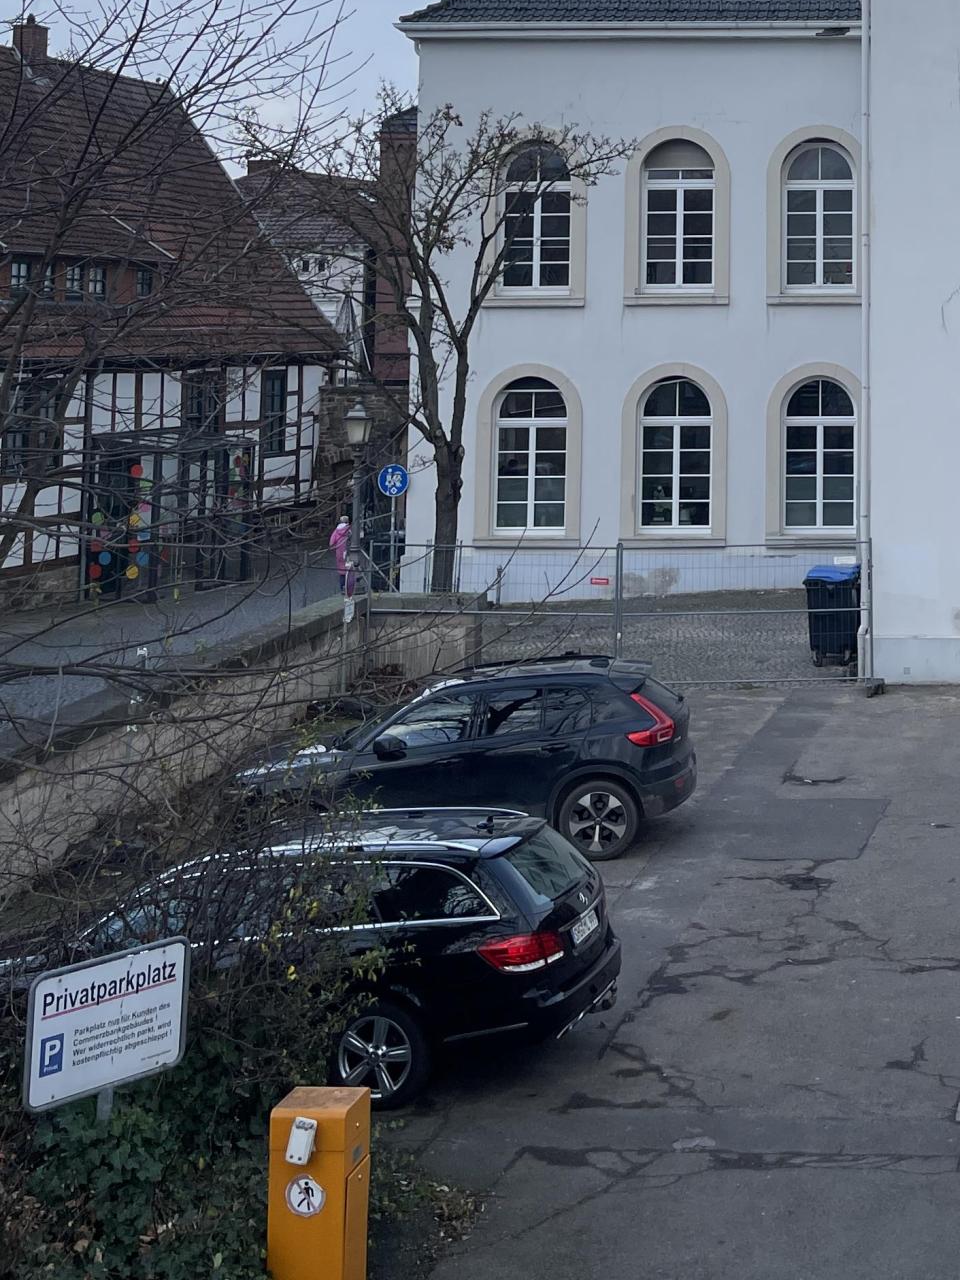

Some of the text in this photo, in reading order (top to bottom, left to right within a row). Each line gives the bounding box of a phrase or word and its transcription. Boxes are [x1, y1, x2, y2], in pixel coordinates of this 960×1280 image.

[42, 961, 176, 1016] Privatparkplatz
[74, 1022, 106, 1037] Parkplatz
[121, 1015, 130, 1023] für
[132, 1006, 157, 1018] Kunden
[158, 1002, 170, 1011] des
[72, 1046, 123, 1066] kostenpflichtig
[73, 1020, 172, 1057] Wer widerrechtlich parkt, wird
